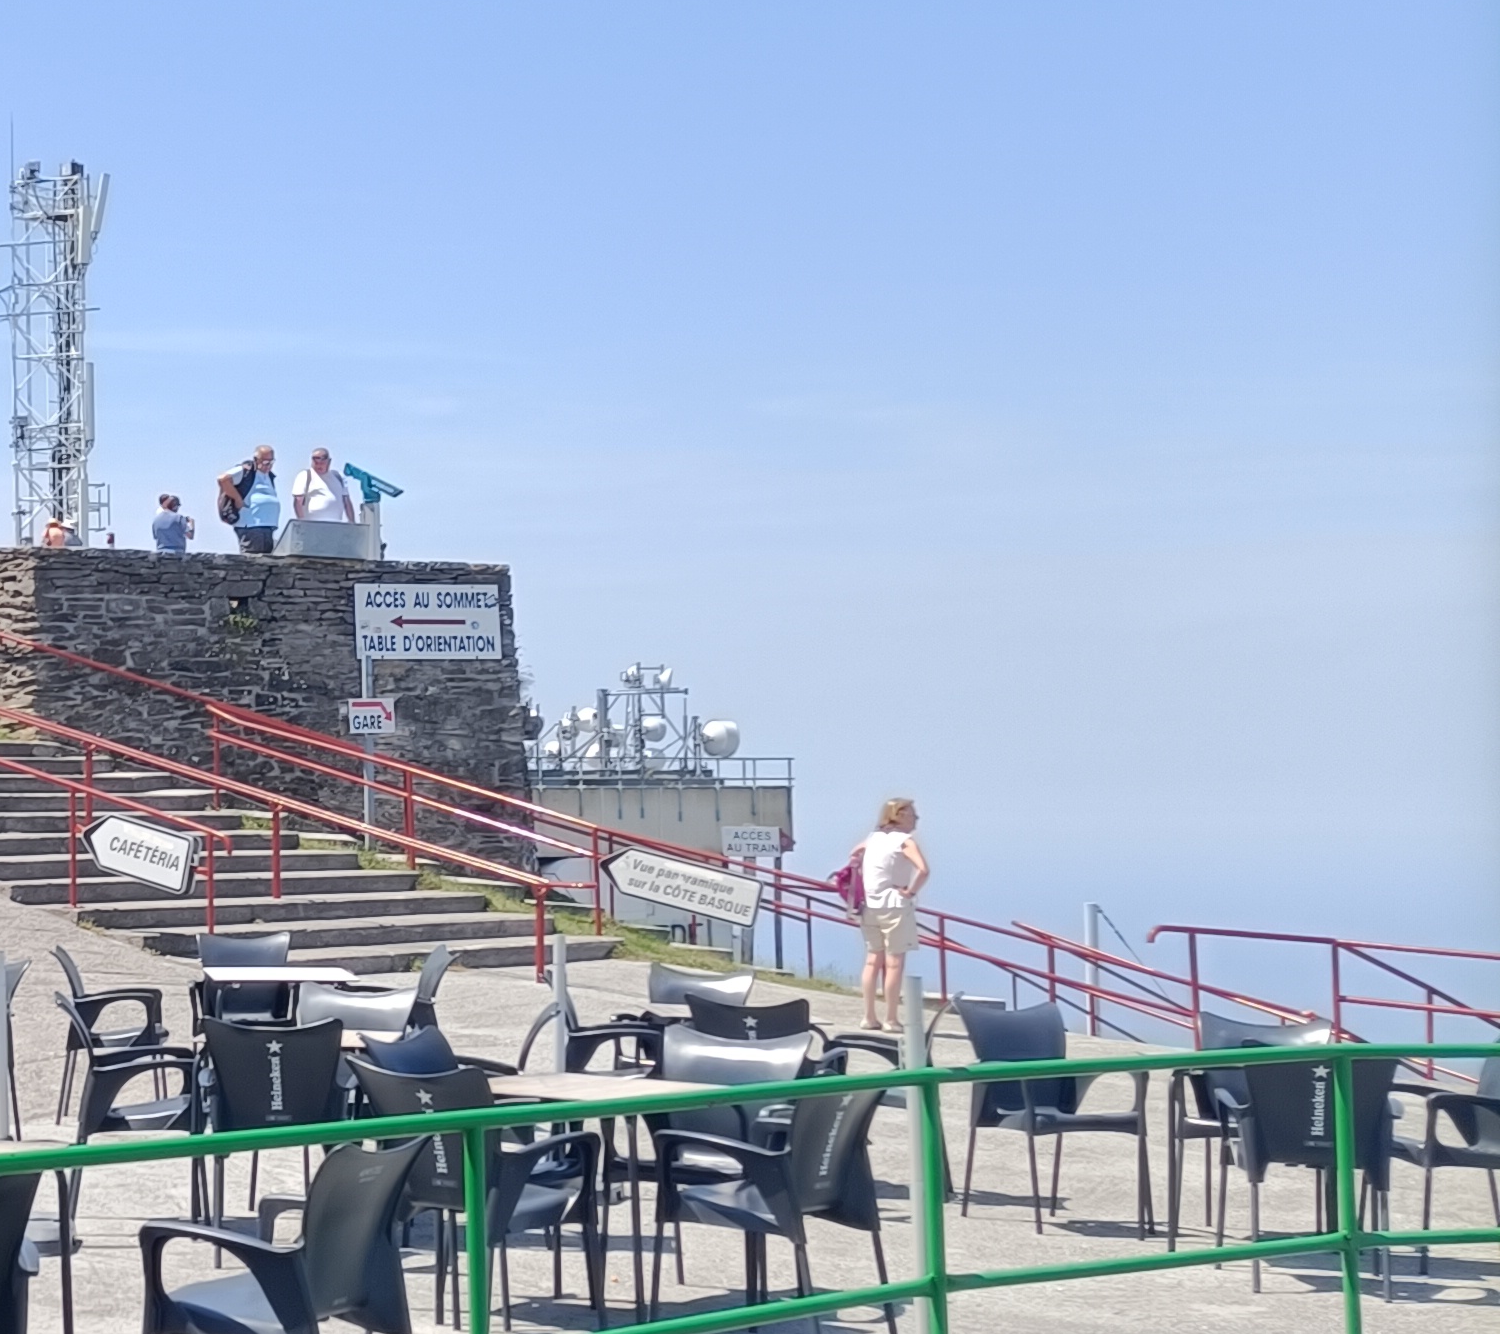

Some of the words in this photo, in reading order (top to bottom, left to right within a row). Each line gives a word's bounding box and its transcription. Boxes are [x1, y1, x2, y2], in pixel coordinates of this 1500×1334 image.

[413, 592, 430, 609] AU
[436, 592, 488, 609] SOMMET
[361, 635, 396, 652] TABLE
[403, 634, 496, 652] D'ORIENTATION
[352, 715, 383, 730] GARE
[109, 836, 181, 871] CAFÉTÉRIA
[726, 843, 742, 853] AU
[746, 843, 779, 853] TRAIN
[632, 858, 654, 875] Vue
[627, 876, 646, 890] sur
[648, 882, 661, 894] la
[699, 893, 752, 918] BASQUE
[269, 1056, 283, 1110] Heineken
[1310, 1081, 1326, 1136] Heineken
